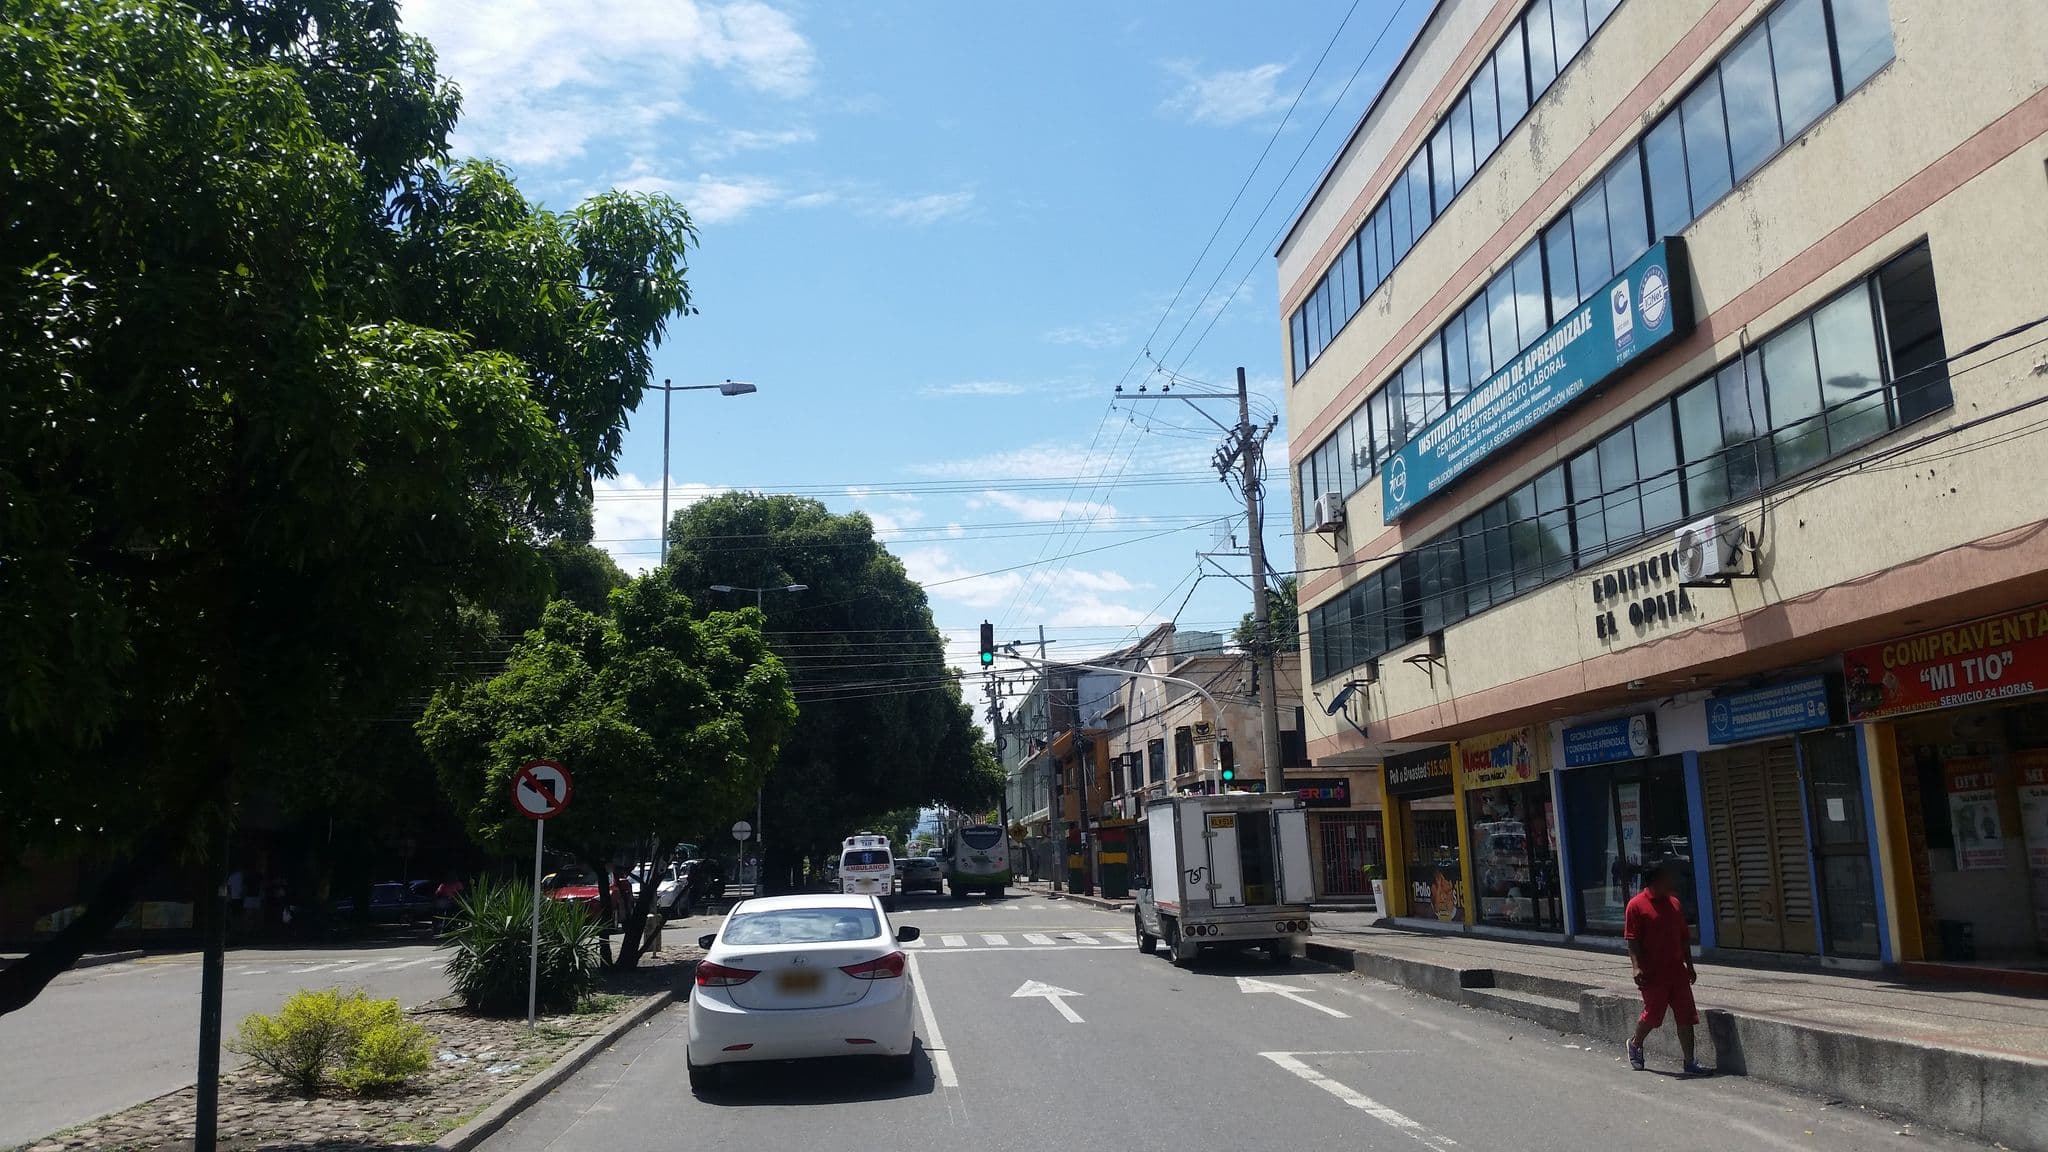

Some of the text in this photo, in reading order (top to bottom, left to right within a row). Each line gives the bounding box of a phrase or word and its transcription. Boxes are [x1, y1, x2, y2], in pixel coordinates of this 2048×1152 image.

[1418, 305, 1592, 457] INSTITUTO COLOMBIANO DE APRENDIZAJE
[1436, 351, 1565, 459] CENTRO DE ENTRENAMIENTO LABORAL
[1596, 611, 1617, 639] EL
[1882, 611, 2048, 669] COMPRAVENTA
[1940, 681, 2034, 706] SERVICIO 24 HORAS
[1732, 709, 1770, 726] PROGRAMAS
[846, 864, 889, 872] AMBULANCIA
[1416, 881, 1431, 897] Pollo
